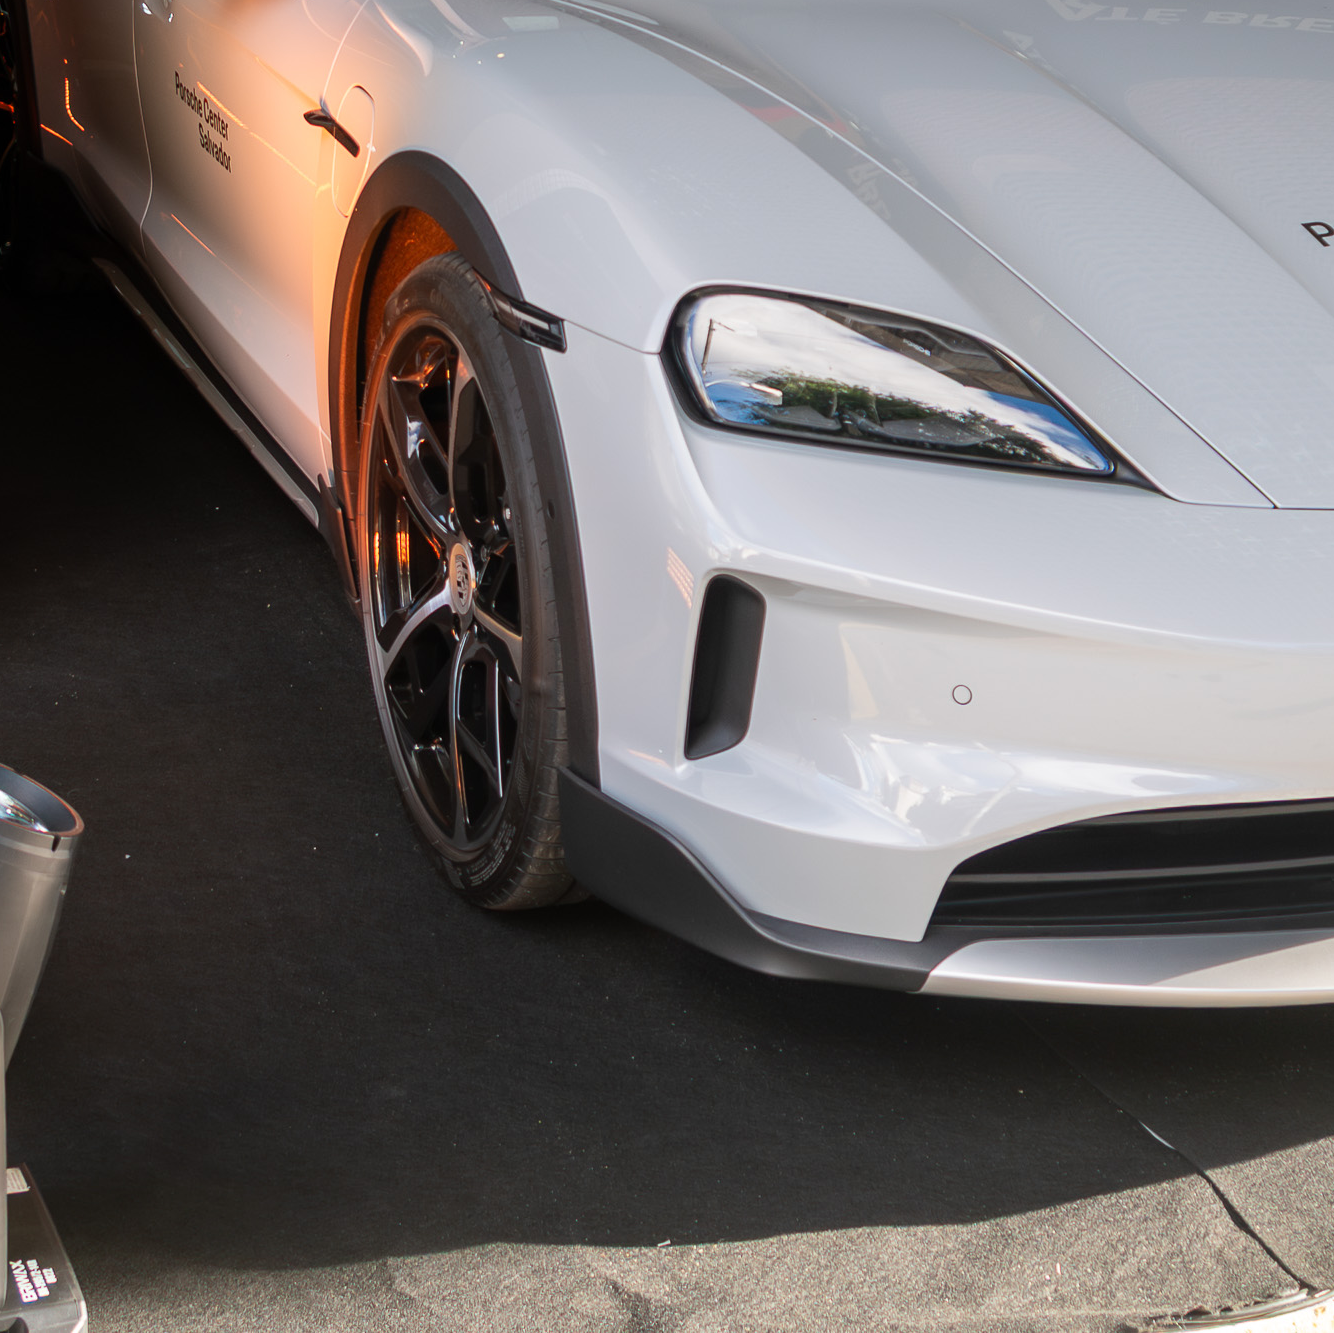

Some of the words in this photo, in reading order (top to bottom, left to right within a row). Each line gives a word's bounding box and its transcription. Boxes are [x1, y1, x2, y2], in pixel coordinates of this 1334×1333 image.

[174, 70, 203, 118] Porsche
[203, 97, 229, 141] Center
[198, 122, 232, 173] Salvador
[9, 1259, 38, 1303] BRIWAX
